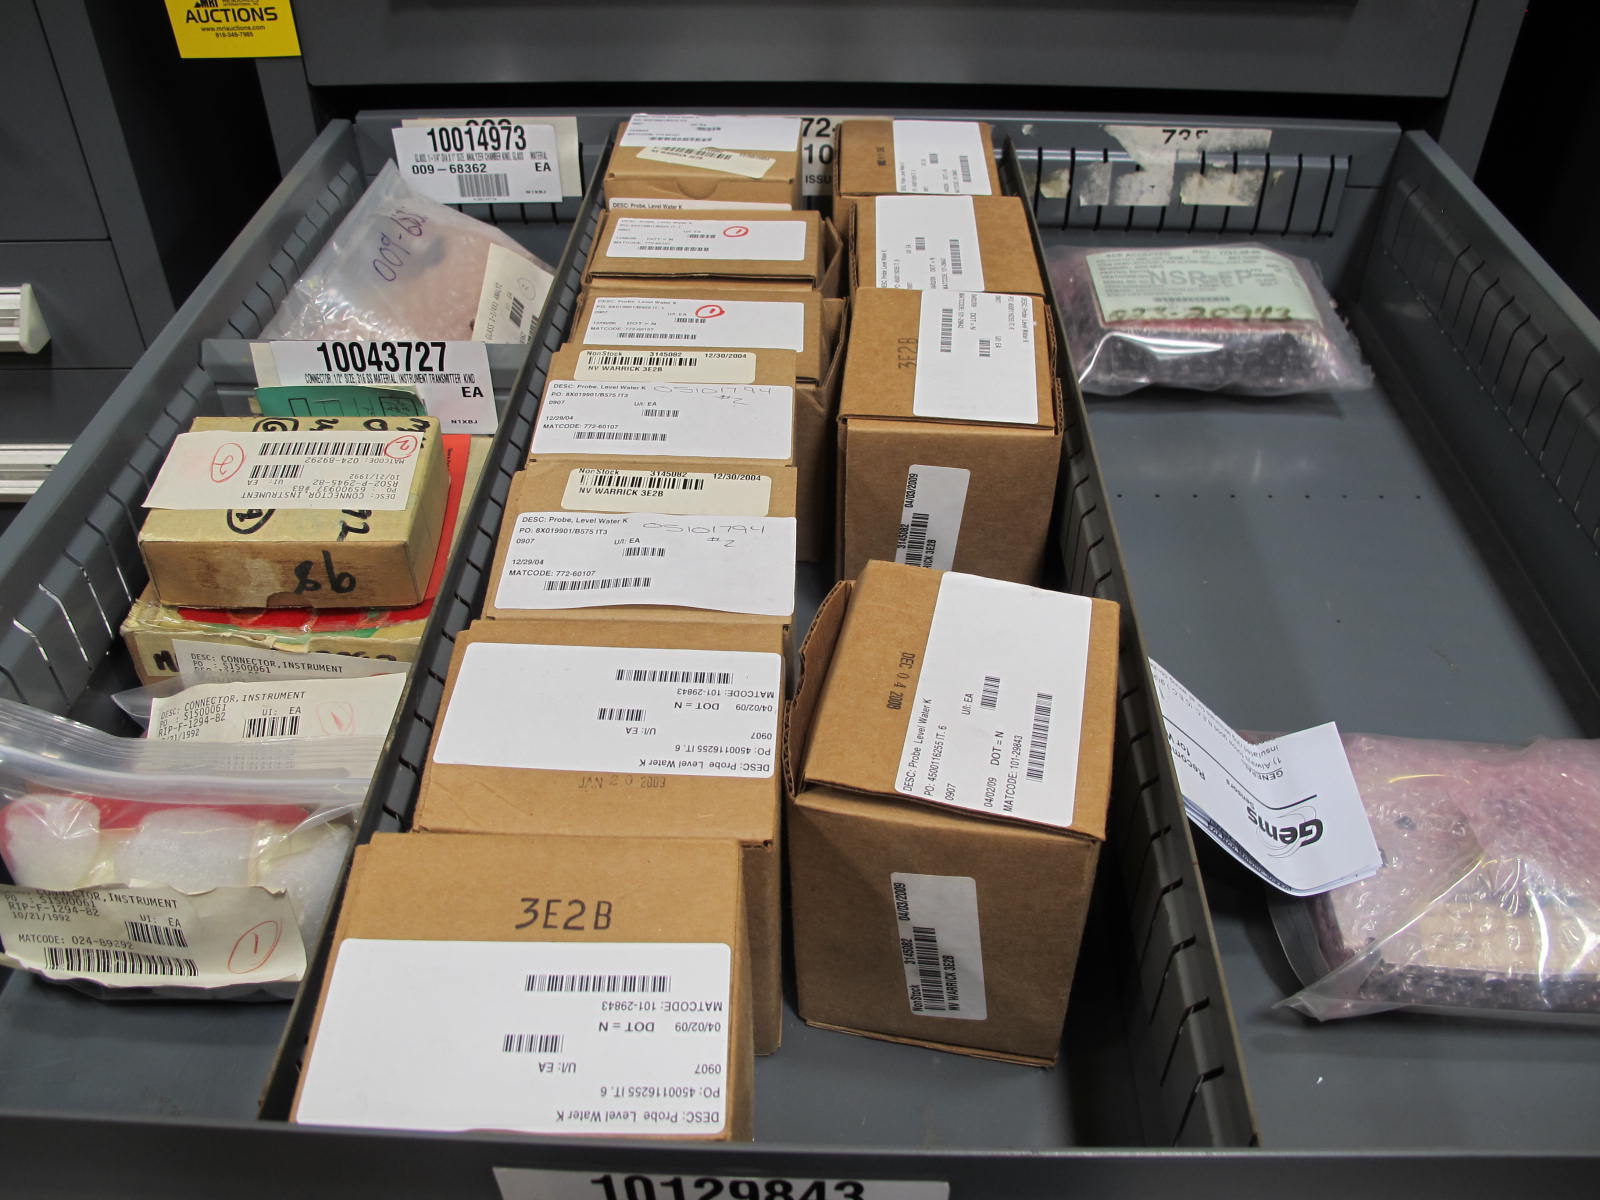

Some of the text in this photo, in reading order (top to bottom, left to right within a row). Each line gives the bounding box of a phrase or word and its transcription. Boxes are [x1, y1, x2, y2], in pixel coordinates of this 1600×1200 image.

[186, 7, 278, 23] AUCTIONS
[427, 125, 527, 152] 10014973
[535, 162, 551, 171] EA
[805, 174, 831, 184] ISSU
[317, 341, 446, 372] 10043727
[399, 373, 427, 383] INSTRUMENT
[462, 386, 483, 398] EA
[712, 473, 761, 481] 12/30/2004
[370, 492, 396, 500] DESC:
[594, 488, 638, 496] WARRICK
[905, 473, 918, 508] 04/03/2009
[191, 652, 215, 662] DESC:
[899, 652, 916, 669] DEC
[677, 687, 775, 699] MATCODE: 101-29843
[674, 701, 720, 710] DOT N
[735, 703, 773, 712] 04/02/09
[962, 693, 974, 715] U/I: EA
[161, 707, 180, 719] DESC:
[918, 704, 930, 724] Water
[625, 726, 657, 735] U/I: EA
[750, 732, 773, 740] 0907
[914, 725, 925, 744] Level
[697, 745, 771, 756] PO: 4500116255
[991, 730, 1005, 766] DOT N
[648, 759, 676, 768] Water
[909, 747, 921, 768] Probe
[678, 759, 704, 770] Level
[709, 760, 737, 771] Probe
[740, 762, 770, 772] DESC:
[924, 740, 944, 796] PO: 4500116255
[1003, 735, 1023, 813] MATCODE: 101-29843
[903, 769, 917, 792] DESC:
[945, 783, 957, 800] 0907
[984, 777, 997, 808] 04/02/09
[1246, 806, 1324, 847] Gems
[894, 882, 910, 921] 04/03/2009
[12, 912, 70, 922] 10/21/1992
[515, 897, 613, 930] 3E2B
[168, 918, 181, 927] EA
[19, 934, 134, 950] MATCODE: 024-89292
[945, 972, 959, 1001] WARRICK
[909, 984, 923, 1012] NonStock
[601, 1000, 723, 1012] MATCODE: 101-29843
[948, 1002, 960, 1011] NV
[598, 1021, 655, 1032] DOT N
[674, 1021, 721, 1032] 04/02/09
[538, 1062, 577, 1073] U/I: EA
[694, 1063, 722, 1074] 0907
[628, 1087, 720, 1098] PO: 4500116255
[556, 1110, 719, 1123] DESC: Probe Level Water K
